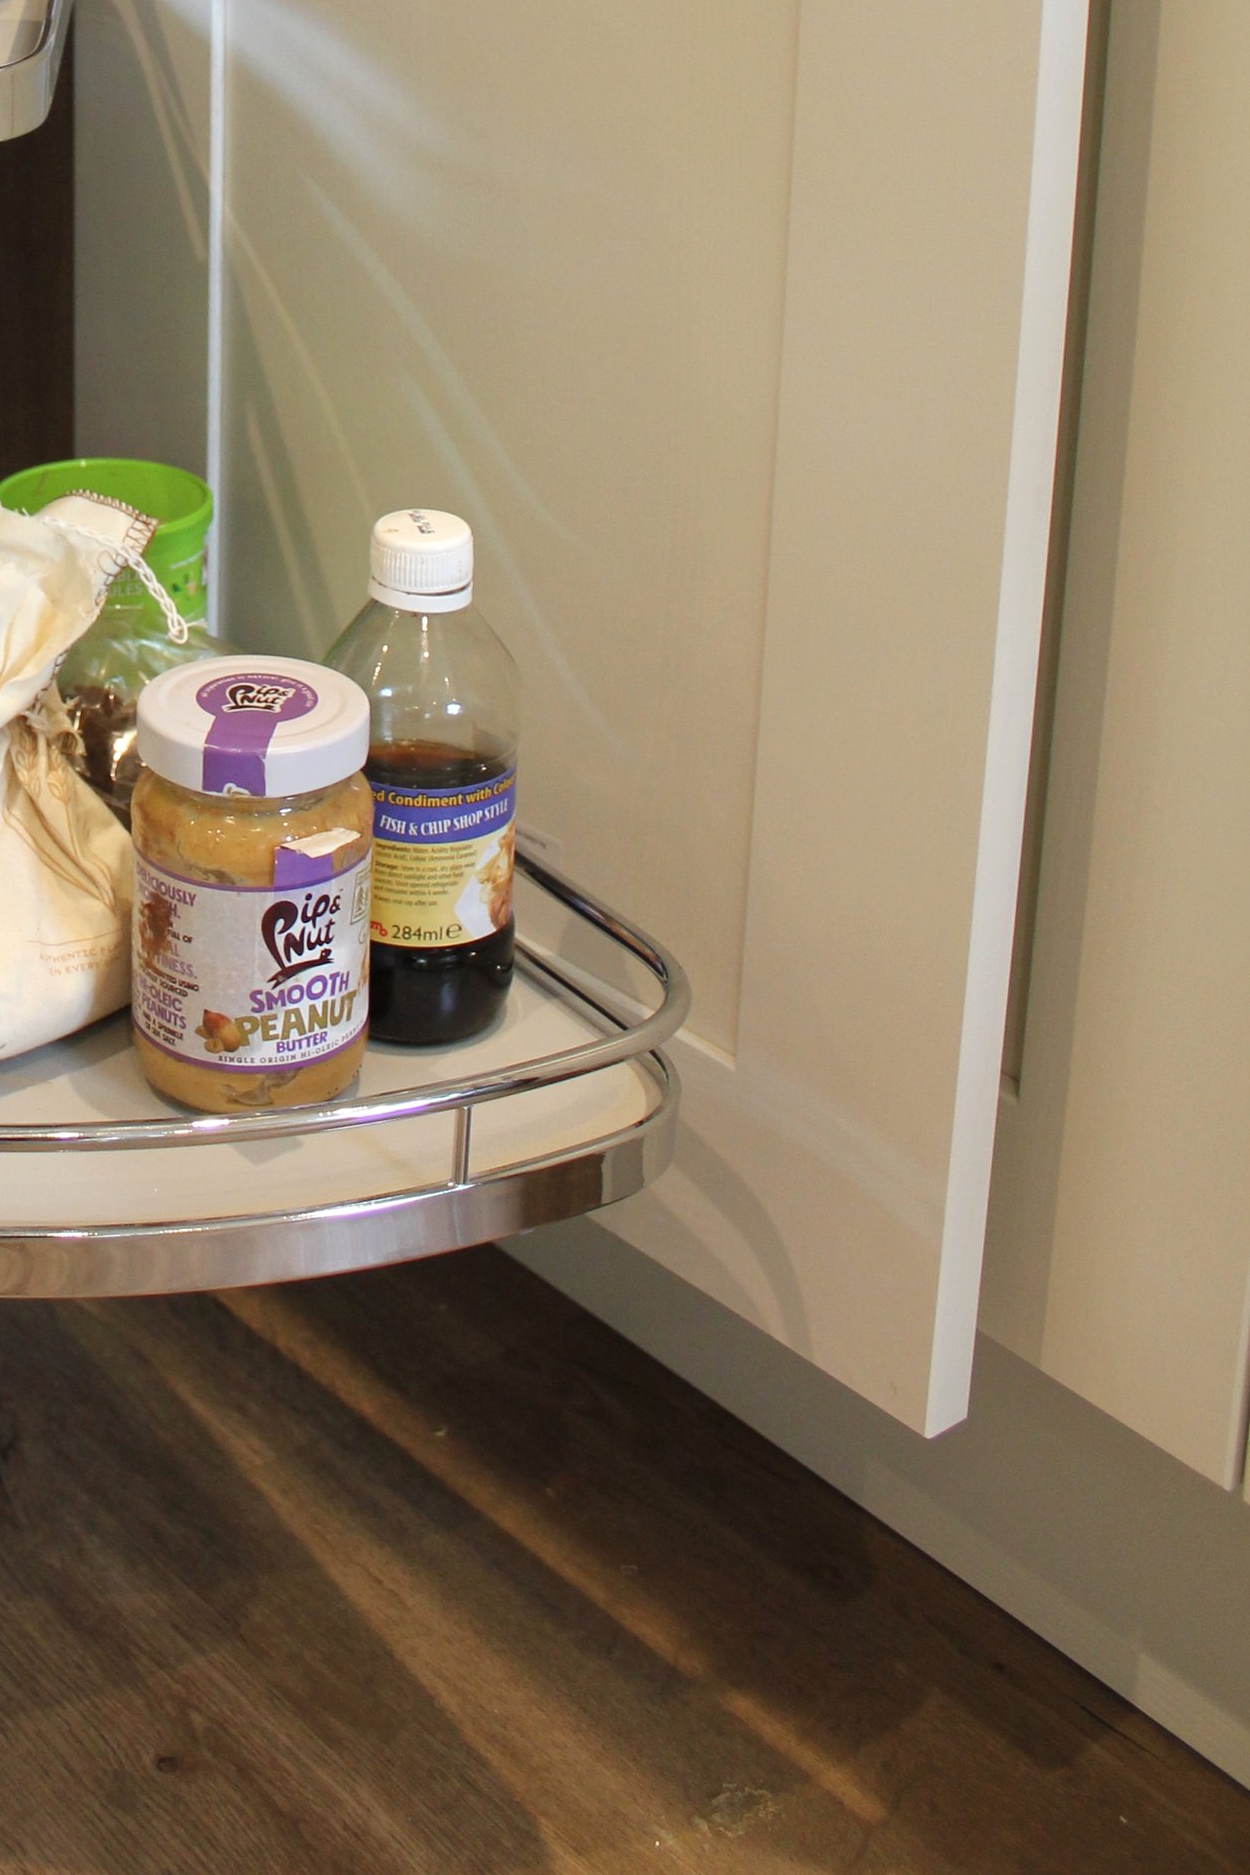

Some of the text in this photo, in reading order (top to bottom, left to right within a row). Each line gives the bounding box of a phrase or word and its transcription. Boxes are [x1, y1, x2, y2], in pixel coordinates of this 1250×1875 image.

[388, 791, 464, 808] Condiment
[465, 786, 492, 803] with
[379, 798, 509, 837] FISH & CHIP SHOP STYLE
[282, 919, 336, 963] Nut
[391, 924, 443, 941] 284ml
[141, 991, 187, 1030] PEANUTS
[249, 971, 351, 1014] SMOOTH
[234, 988, 358, 1048] PEANUT
[218, 1037, 341, 1064] SINGLE ORIGIN HI-OLEIC
[276, 1031, 329, 1054] BUTTER
